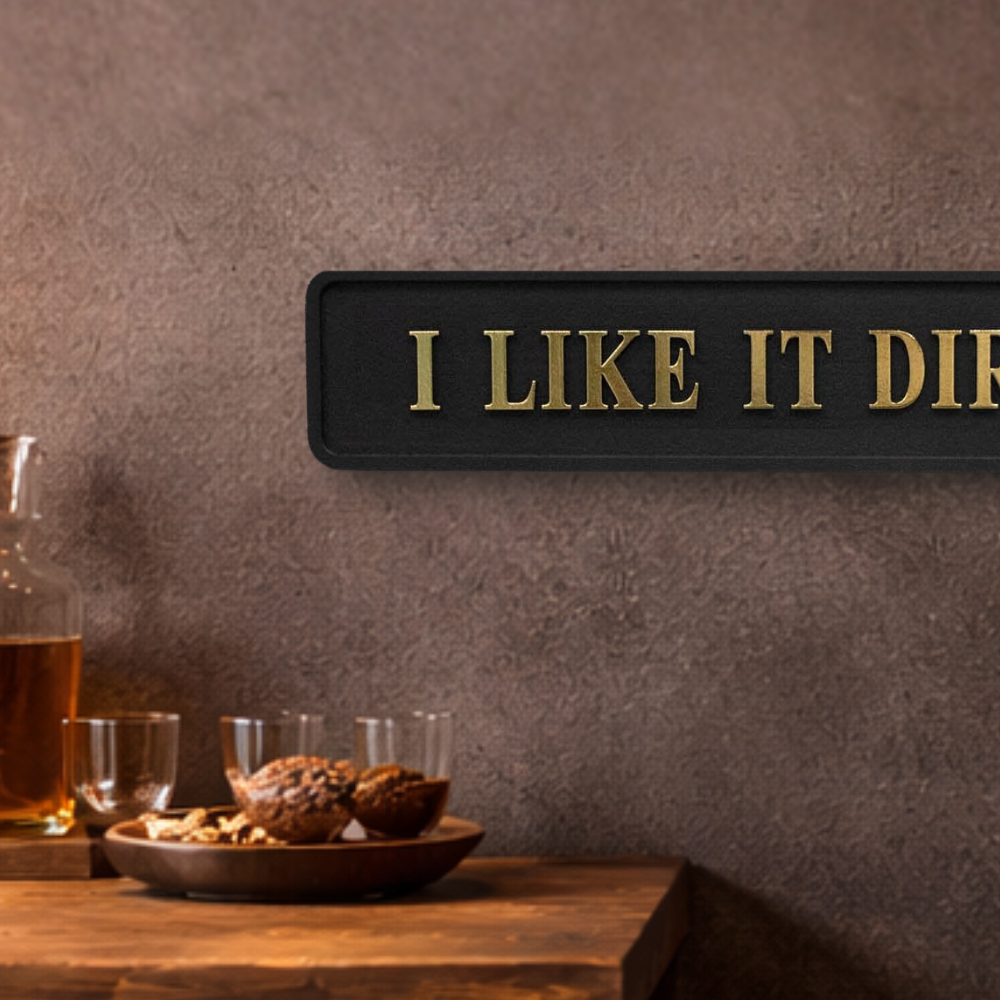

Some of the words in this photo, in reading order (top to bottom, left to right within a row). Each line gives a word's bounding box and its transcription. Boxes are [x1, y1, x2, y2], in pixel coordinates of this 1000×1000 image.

[408, 329, 440, 411] I
[483, 329, 699, 411] LIKE
[743, 328, 832, 410] IT
